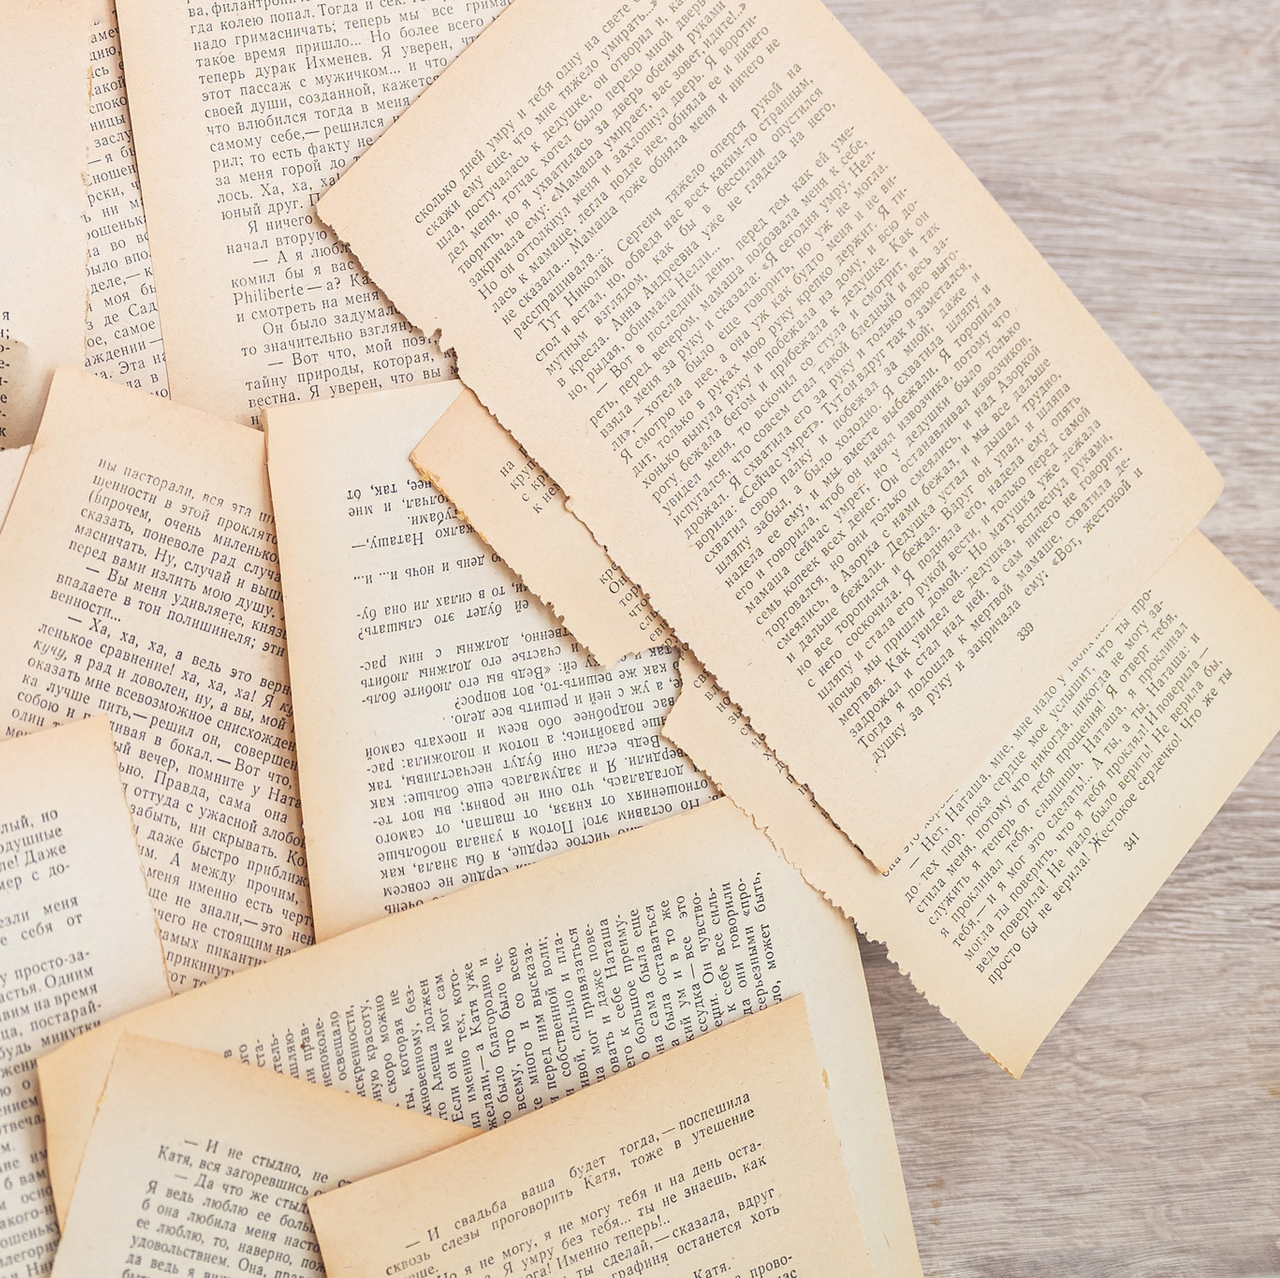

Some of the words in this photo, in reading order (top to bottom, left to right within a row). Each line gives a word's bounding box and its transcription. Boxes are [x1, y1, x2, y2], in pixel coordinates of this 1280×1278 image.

[414, 179, 457, 223] сколько
[459, 148, 485, 180] дней
[485, 119, 515, 152] умру
[527, 81, 553, 106] тебя
[555, 51, 582, 79] одну
[601, 4, 630, 33] свете
[68, 539, 107, 562] перед
[111, 554, 146, 574] вами
[150, 567, 196, 591] излить
[202, 584, 231, 602] мою
[234, 596, 275, 618] душу.
[1016, 621, 1034, 641] 339
[1123, 831, 1140, 851] 341
[385, 1252, 430, 1276] сквозь
[441, 1228, 479, 1252] слезы
[491, 1188, 573, 1230] проговорить
[583, 1167, 620, 1189] Катя,
[630, 1147, 663, 1167] тоже
[691, 1108, 754, 1144] утешение
